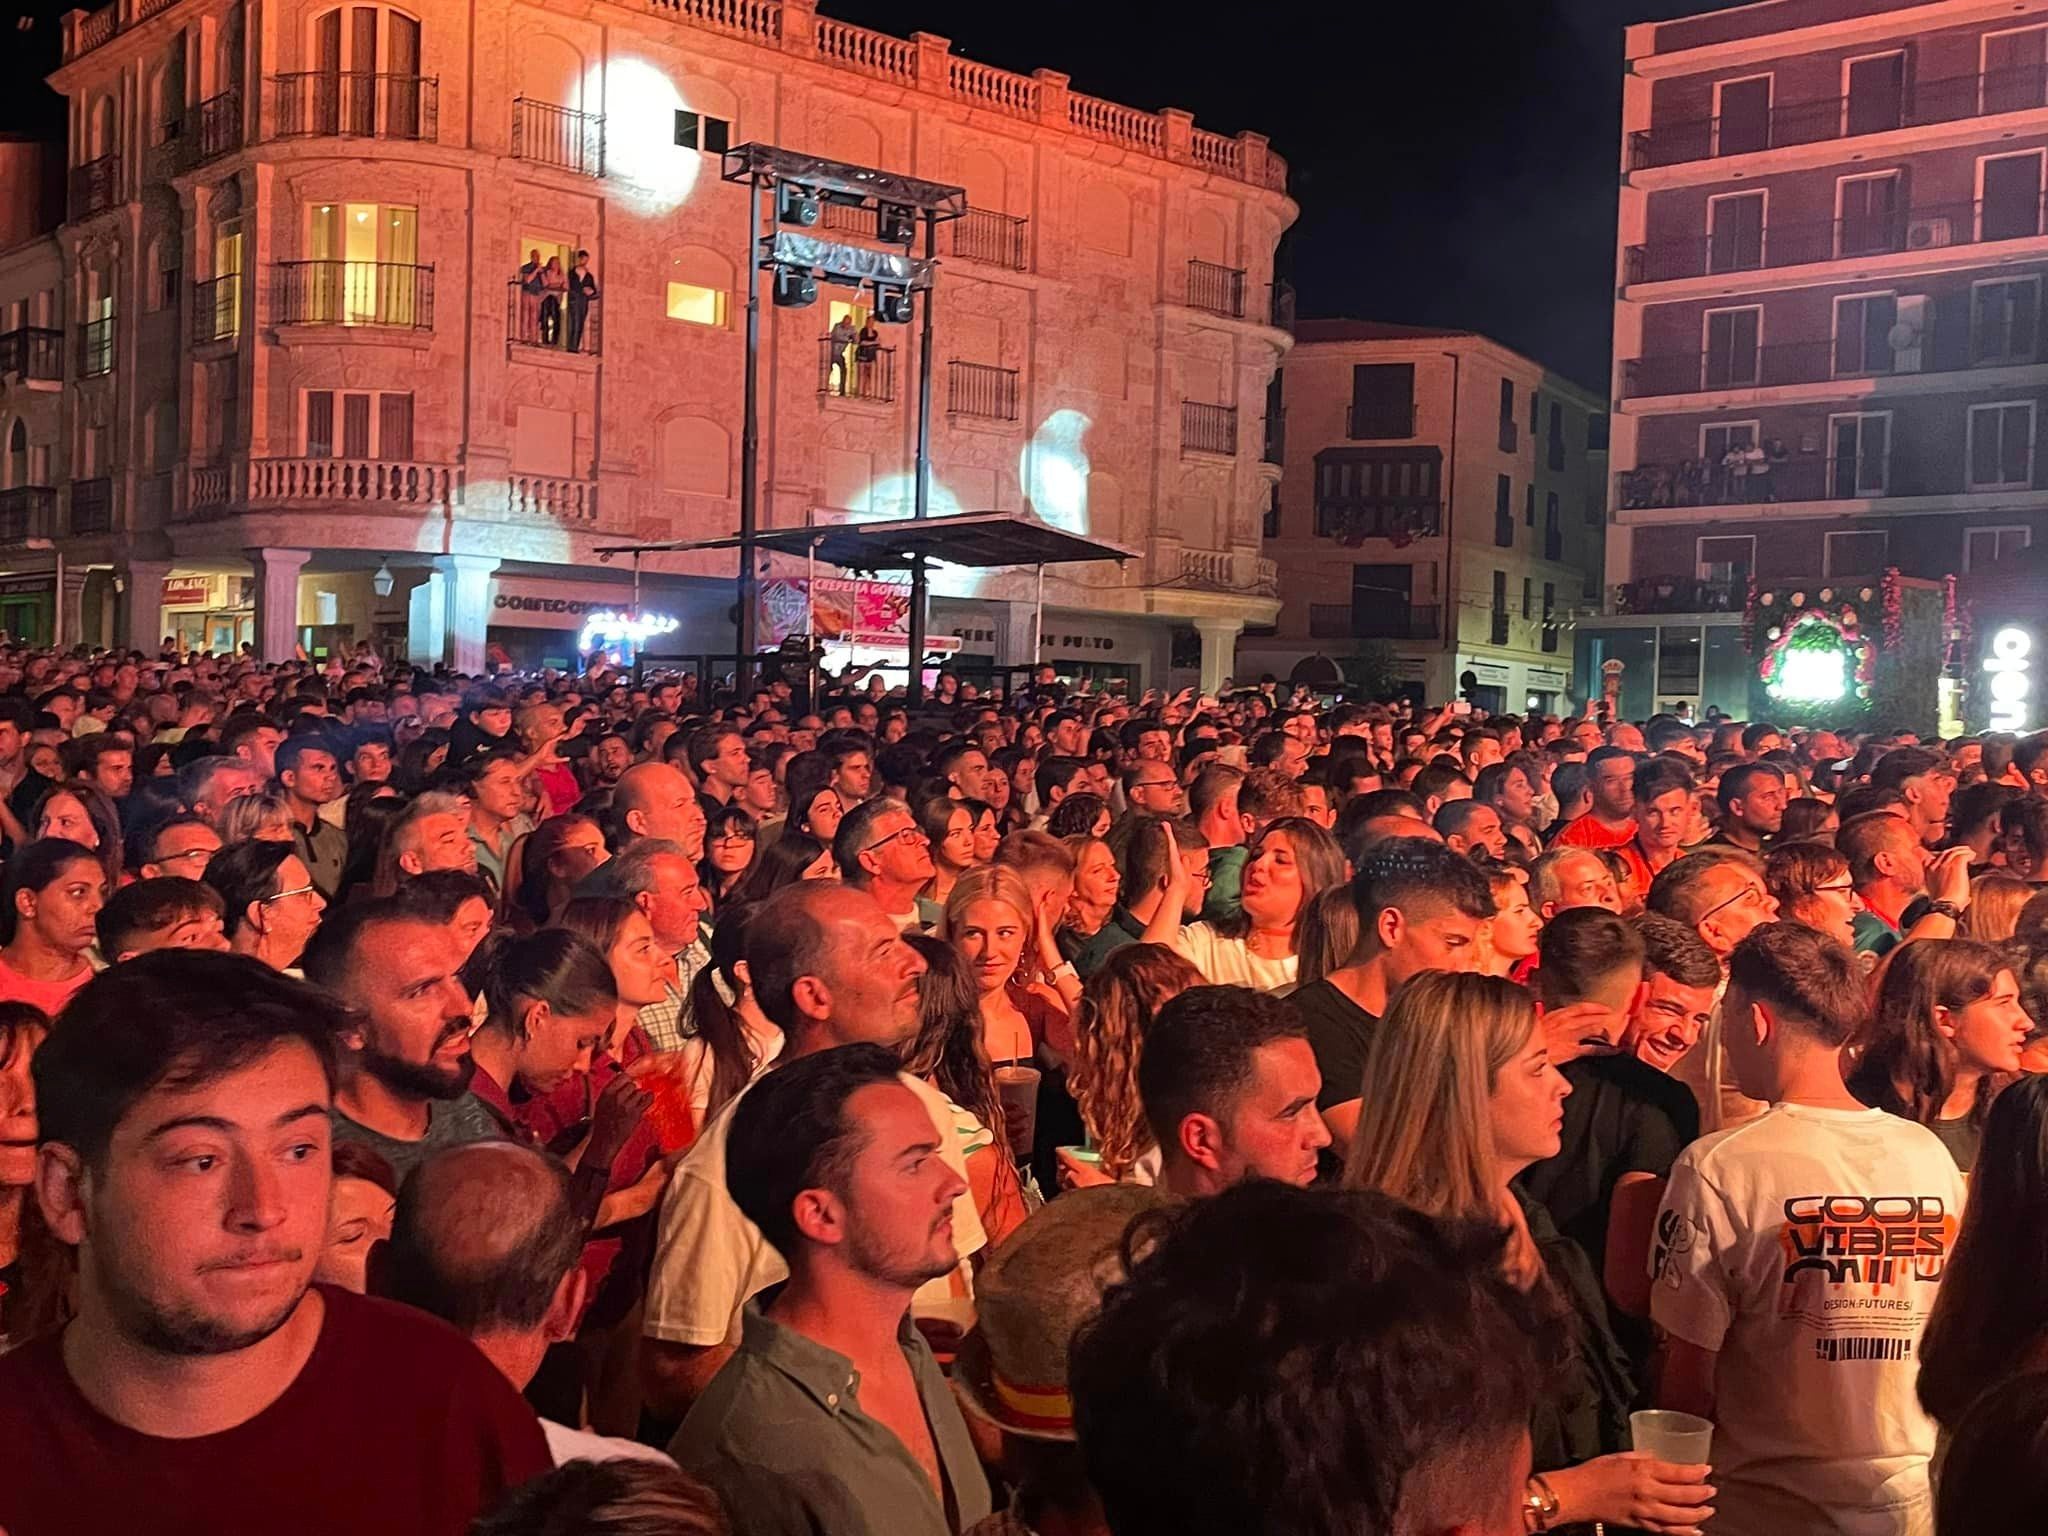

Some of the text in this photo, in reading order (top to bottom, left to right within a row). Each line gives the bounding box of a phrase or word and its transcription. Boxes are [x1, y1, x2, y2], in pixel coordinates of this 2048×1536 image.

[871, 584, 913, 599] GOFRE
[1784, 1196, 1944, 1224] GOOD
[1789, 1226, 1944, 1257] VIBES
